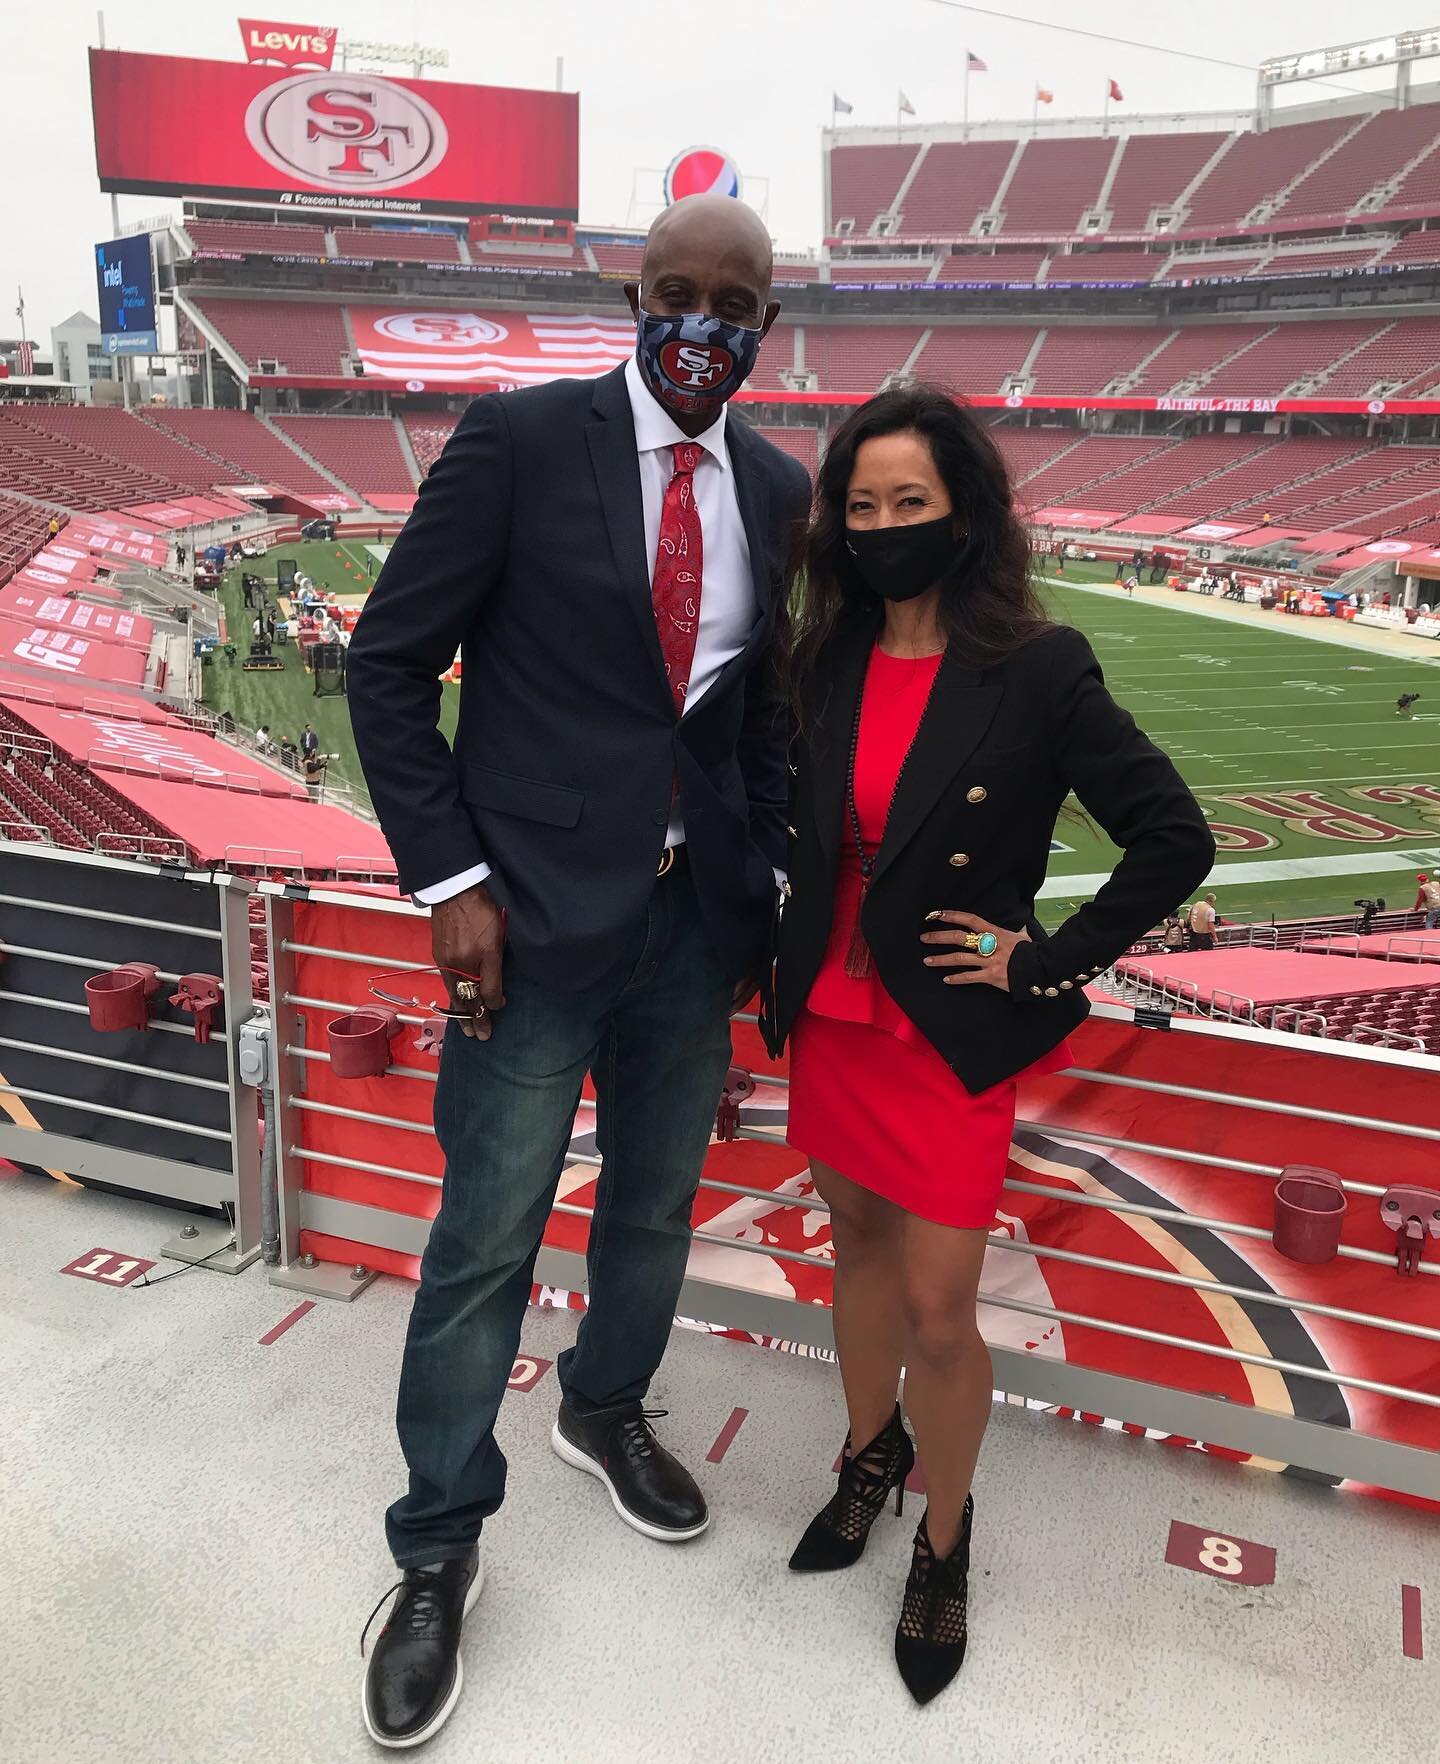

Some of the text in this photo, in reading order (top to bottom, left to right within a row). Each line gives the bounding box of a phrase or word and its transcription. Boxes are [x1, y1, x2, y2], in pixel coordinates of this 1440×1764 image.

[294, 193, 337, 207] Foxconn
[338, 196, 383, 209] Industrial
[384, 199, 422, 212] Internet
[103, 260, 123, 287] intel
[676, 346, 723, 387] SF
[1155, 398, 1216, 411] FAITHFUL
[1224, 399, 1250, 411] THE
[1252, 400, 1280, 412] BAY
[1130, 944, 1147, 954] 129
[73, 1254, 140, 1282] 11
[1198, 1536, 1243, 1575] 8
